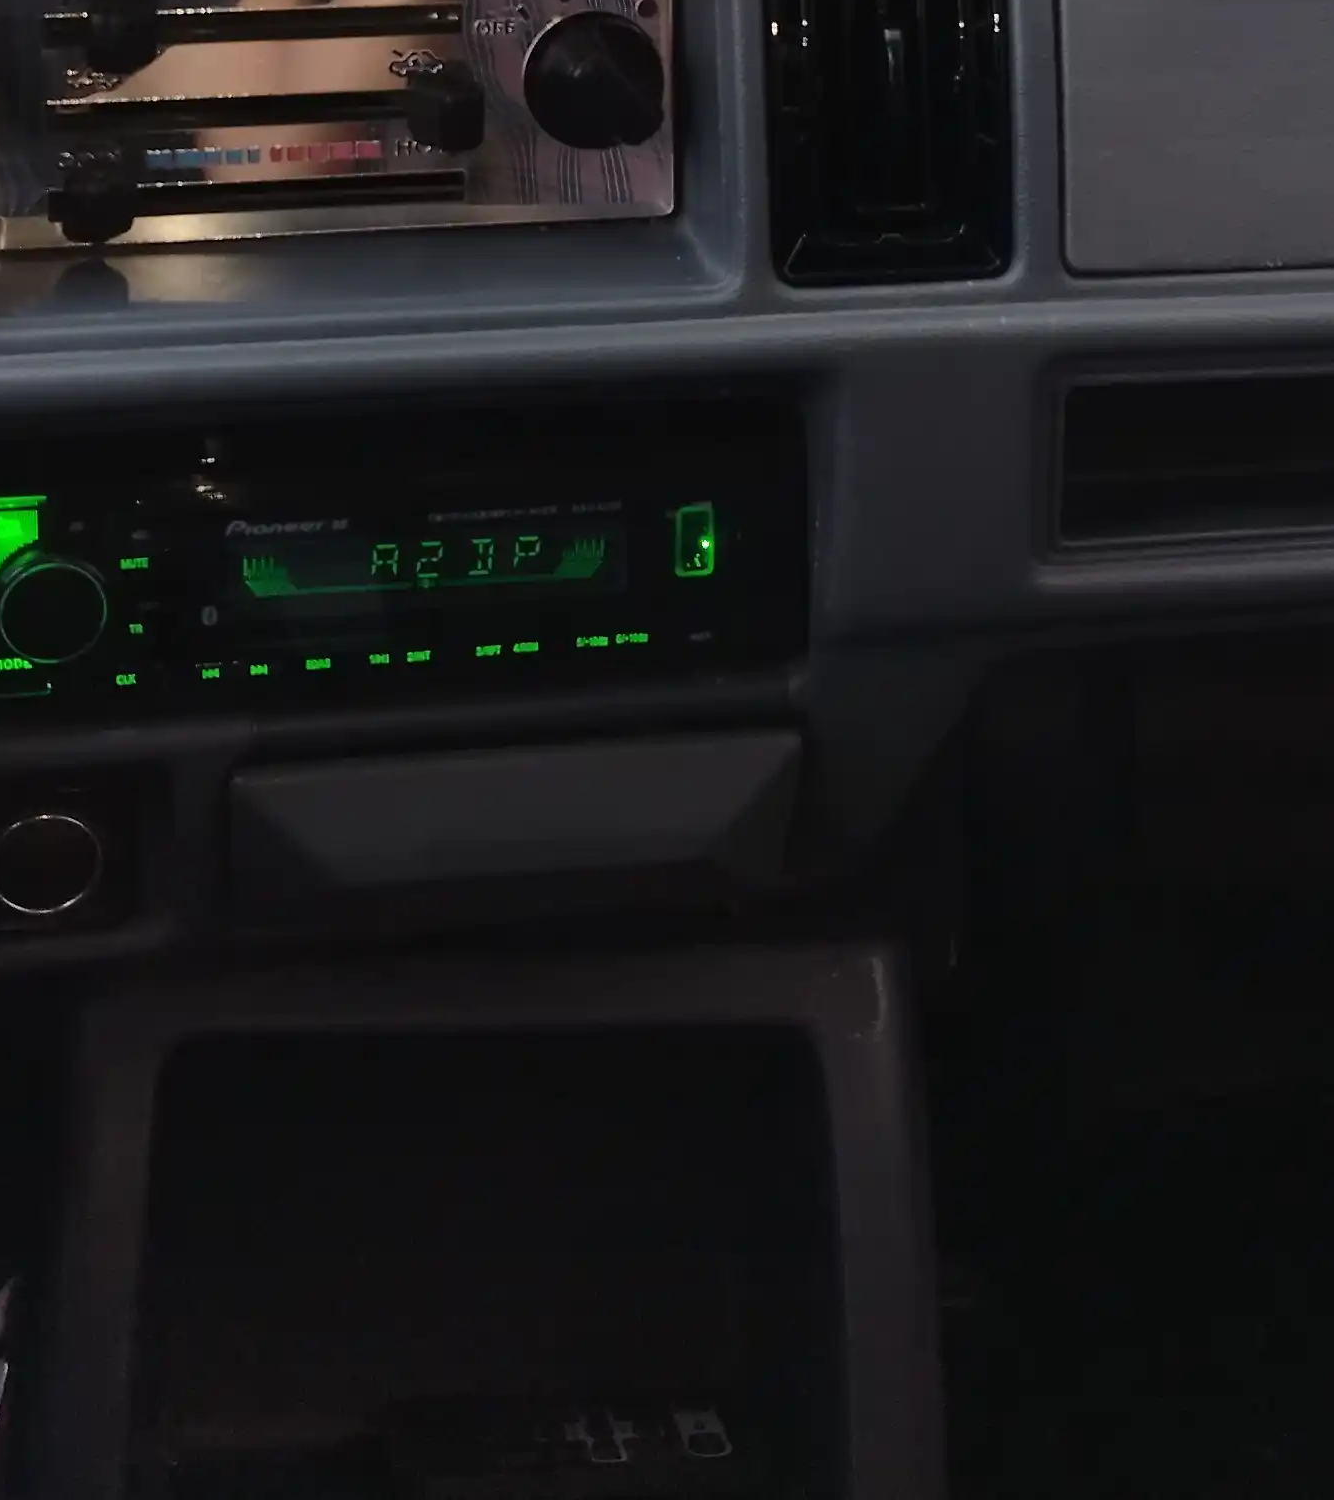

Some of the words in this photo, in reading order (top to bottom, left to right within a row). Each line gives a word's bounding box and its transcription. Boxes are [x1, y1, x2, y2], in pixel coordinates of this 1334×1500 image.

[370, 535, 542, 577] A2DP
[120, 557, 149, 570] MUTE
[115, 673, 137, 686] CLK
